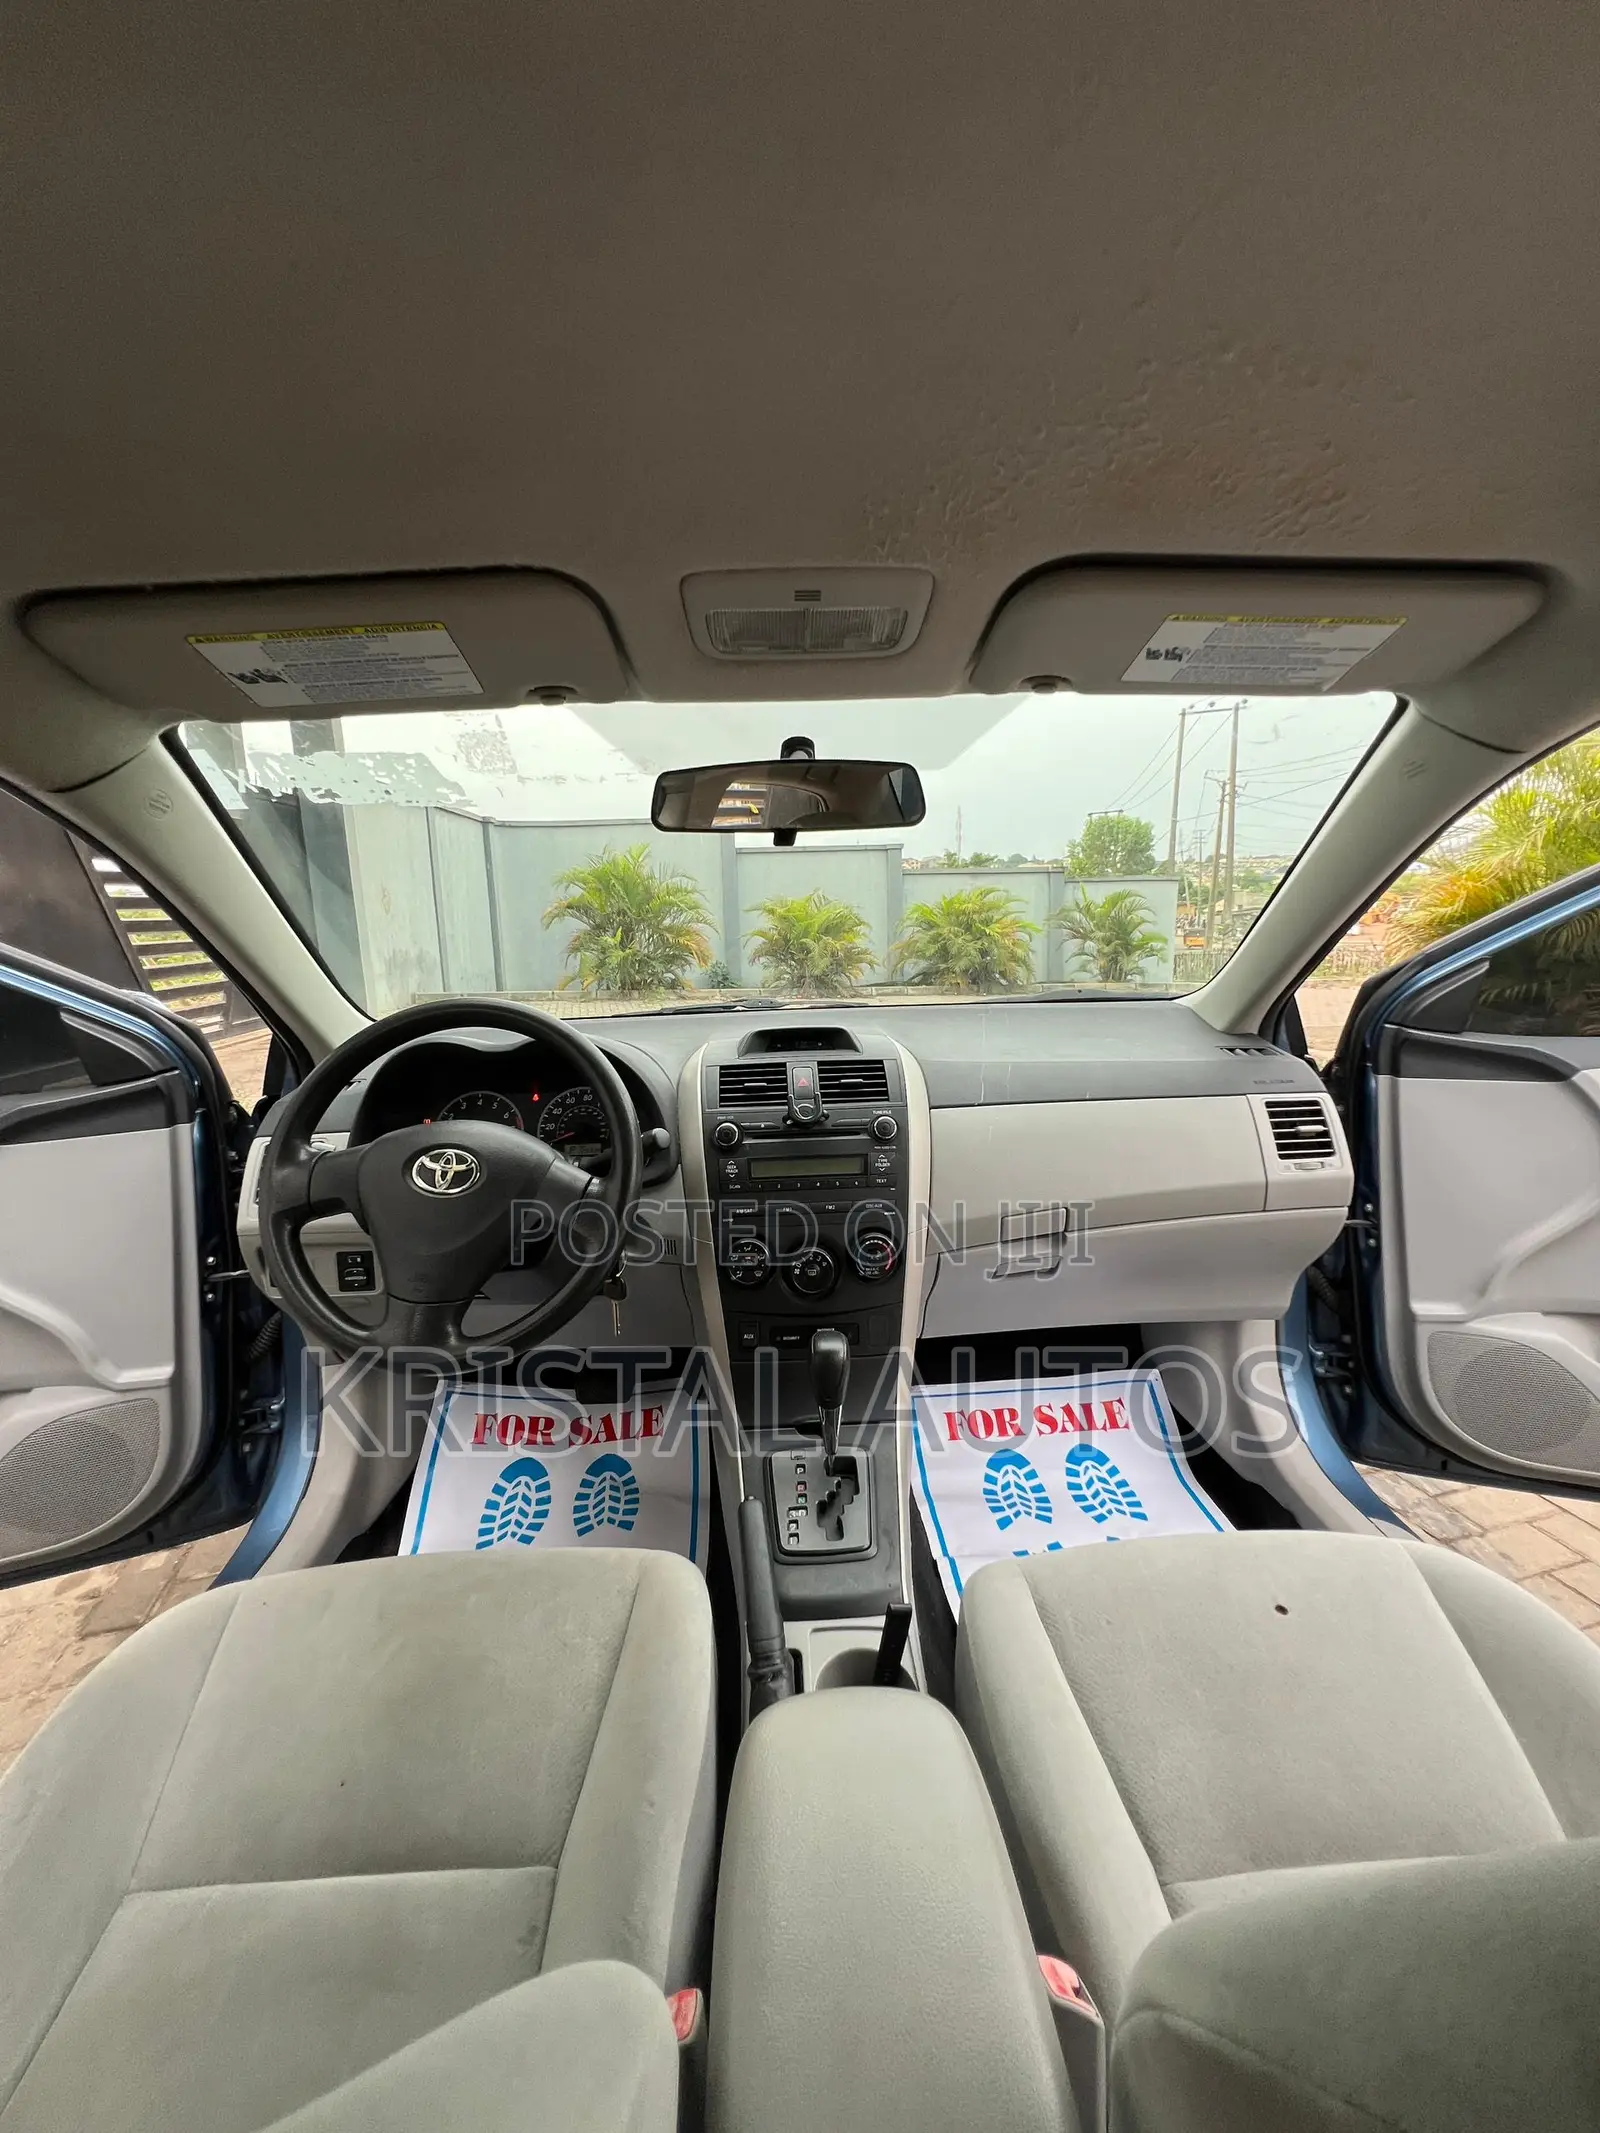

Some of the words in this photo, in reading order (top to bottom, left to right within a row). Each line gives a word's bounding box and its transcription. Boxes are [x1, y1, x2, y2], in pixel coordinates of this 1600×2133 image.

[470, 1412, 558, 1447] FOR
[568, 1404, 665, 1449] SALE
[943, 1405, 1025, 1441] FOR
[1033, 1396, 1130, 1437] SALE
[789, 1523, 797, 1531] 2
